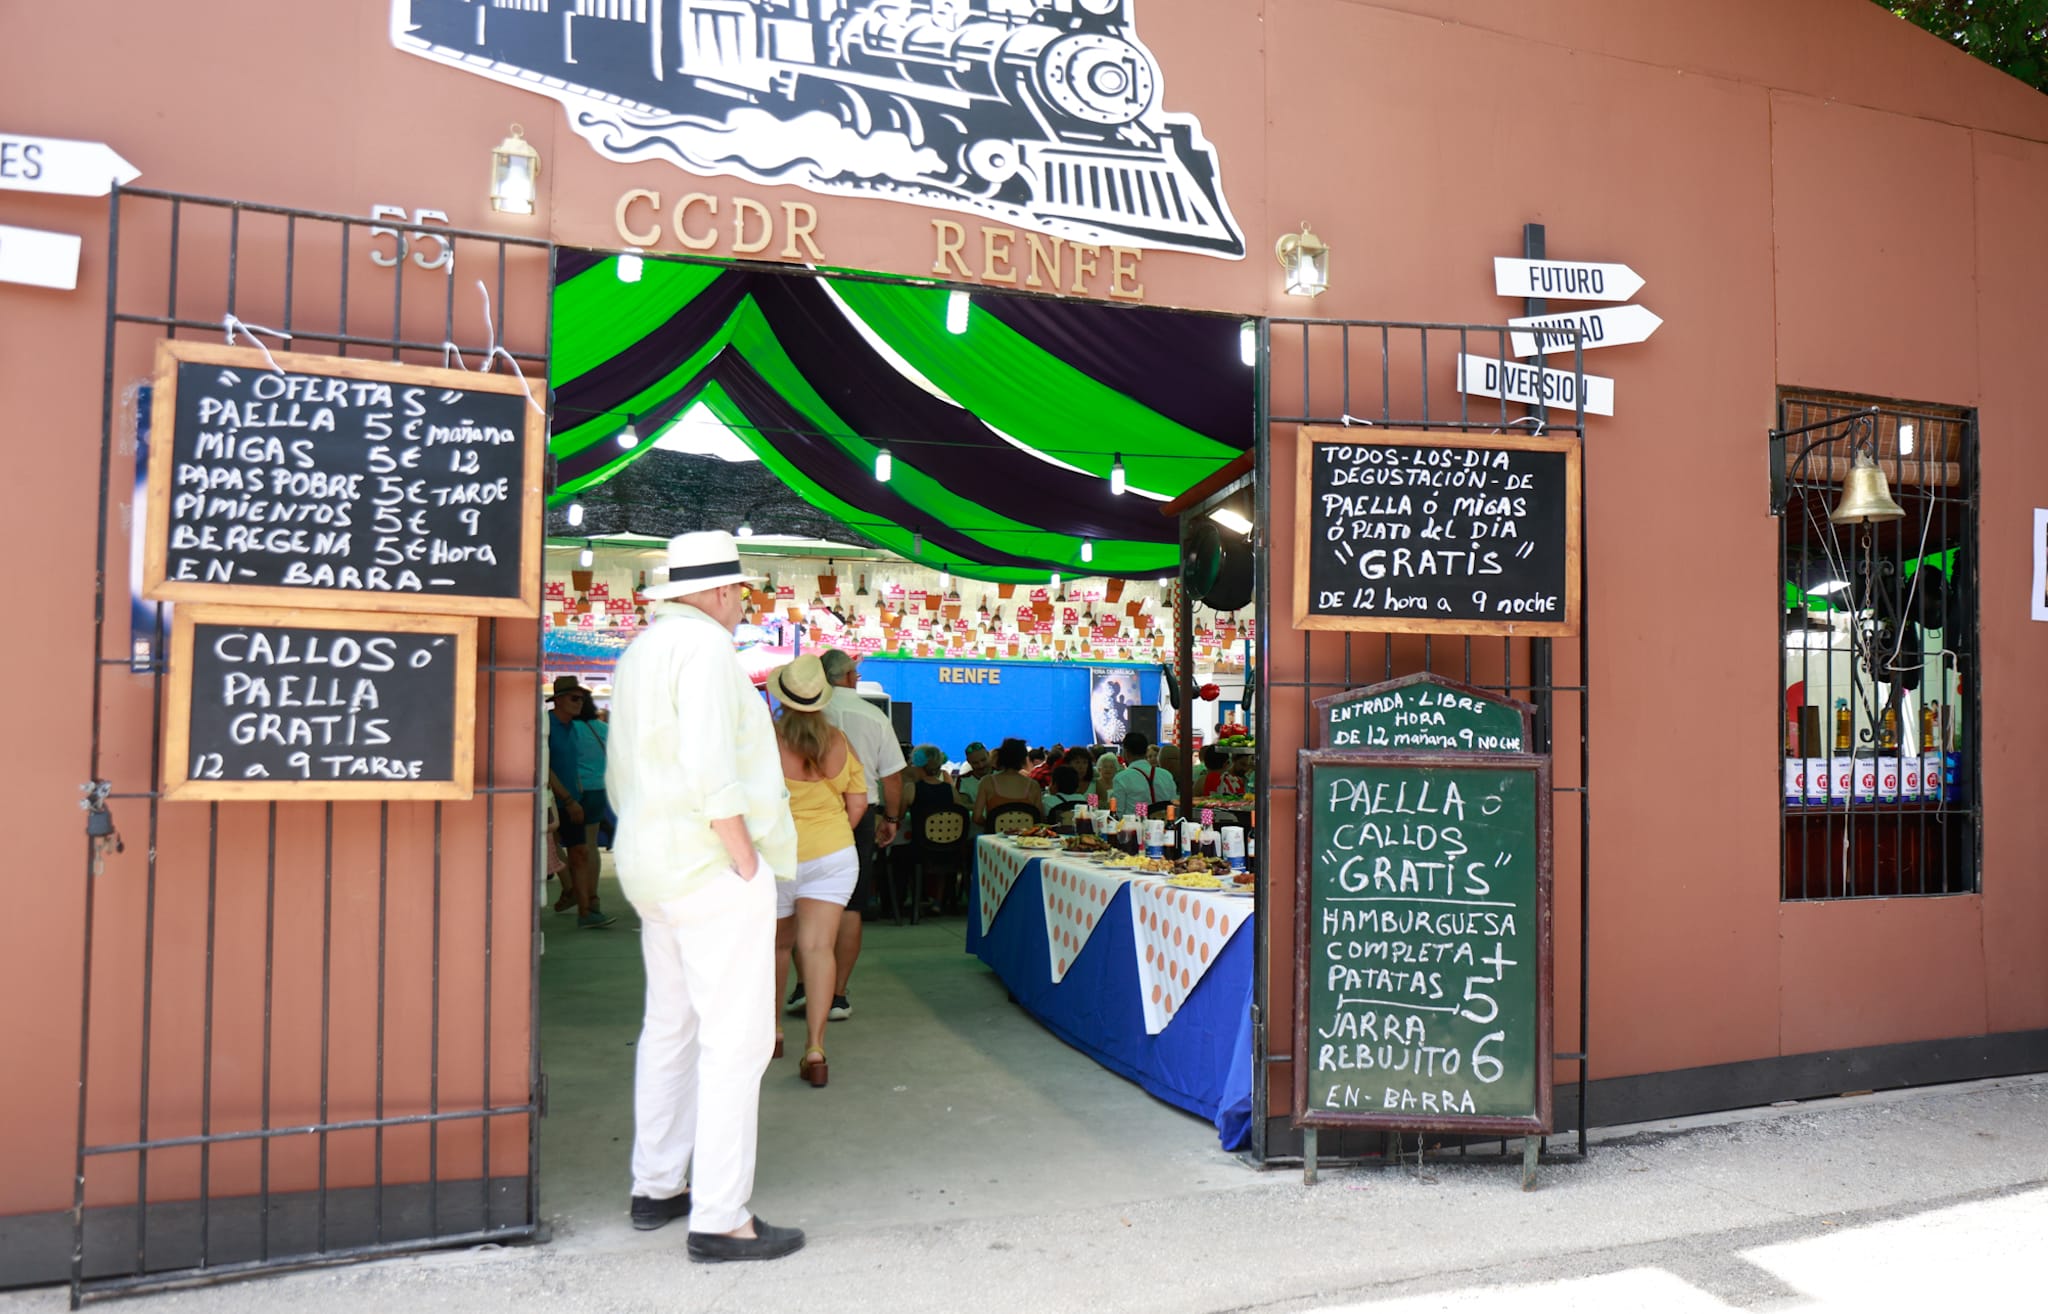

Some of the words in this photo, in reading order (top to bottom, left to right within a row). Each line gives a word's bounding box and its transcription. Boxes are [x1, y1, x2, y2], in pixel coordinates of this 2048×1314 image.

[370, 205, 450, 269] 55
[615, 188, 825, 261] CCDR
[931, 219, 1144, 299] RENFE
[1529, 266, 1604, 294] FUTURO
[1531, 315, 1604, 348] UNIDAD
[199, 397, 336, 432] PAELLA
[449, 449, 480, 474] 12
[178, 464, 264, 491] PAPAS
[273, 468, 364, 500] POBRE
[431, 478, 508, 507] TARDE
[1322, 494, 1412, 517] PAELLA
[460, 509, 481, 536] 9
[1352, 520, 1411, 540] PLATO
[172, 525, 351, 558] BEREGENA
[1319, 591, 1345, 609] DE
[1352, 588, 1376, 609] 12
[1384, 587, 1428, 611] hora
[1437, 593, 1451, 612] a
[1472, 591, 1487, 612] 9
[214, 632, 397, 672] CALLOS
[224, 671, 379, 709] PAELLA
[939, 667, 1001, 684] RENFE
[1395, 712, 1446, 727] HORA
[1334, 731, 1360, 745] DE
[1367, 725, 1389, 745] 12
[1393, 728, 1457, 748] mañana
[1458, 728, 1474, 749] 9
[193, 752, 224, 779] 12
[245, 763, 270, 778] a
[289, 752, 311, 778] 9
[320, 755, 423, 778] TARDE
[1330, 778, 1466, 821] PAELLA
[1333, 823, 1468, 855] CALLOS
[1323, 907, 1516, 936] HAMBURGUESA
[1327, 941, 1474, 966] COMPLETA
[1328, 964, 1443, 999] PATATAS
[1461, 976, 1498, 1023] 5
[1319, 1011, 1425, 1045] JARRA
[1472, 1031, 1505, 1083] 6
[1384, 1087, 1475, 1113] BARRA
